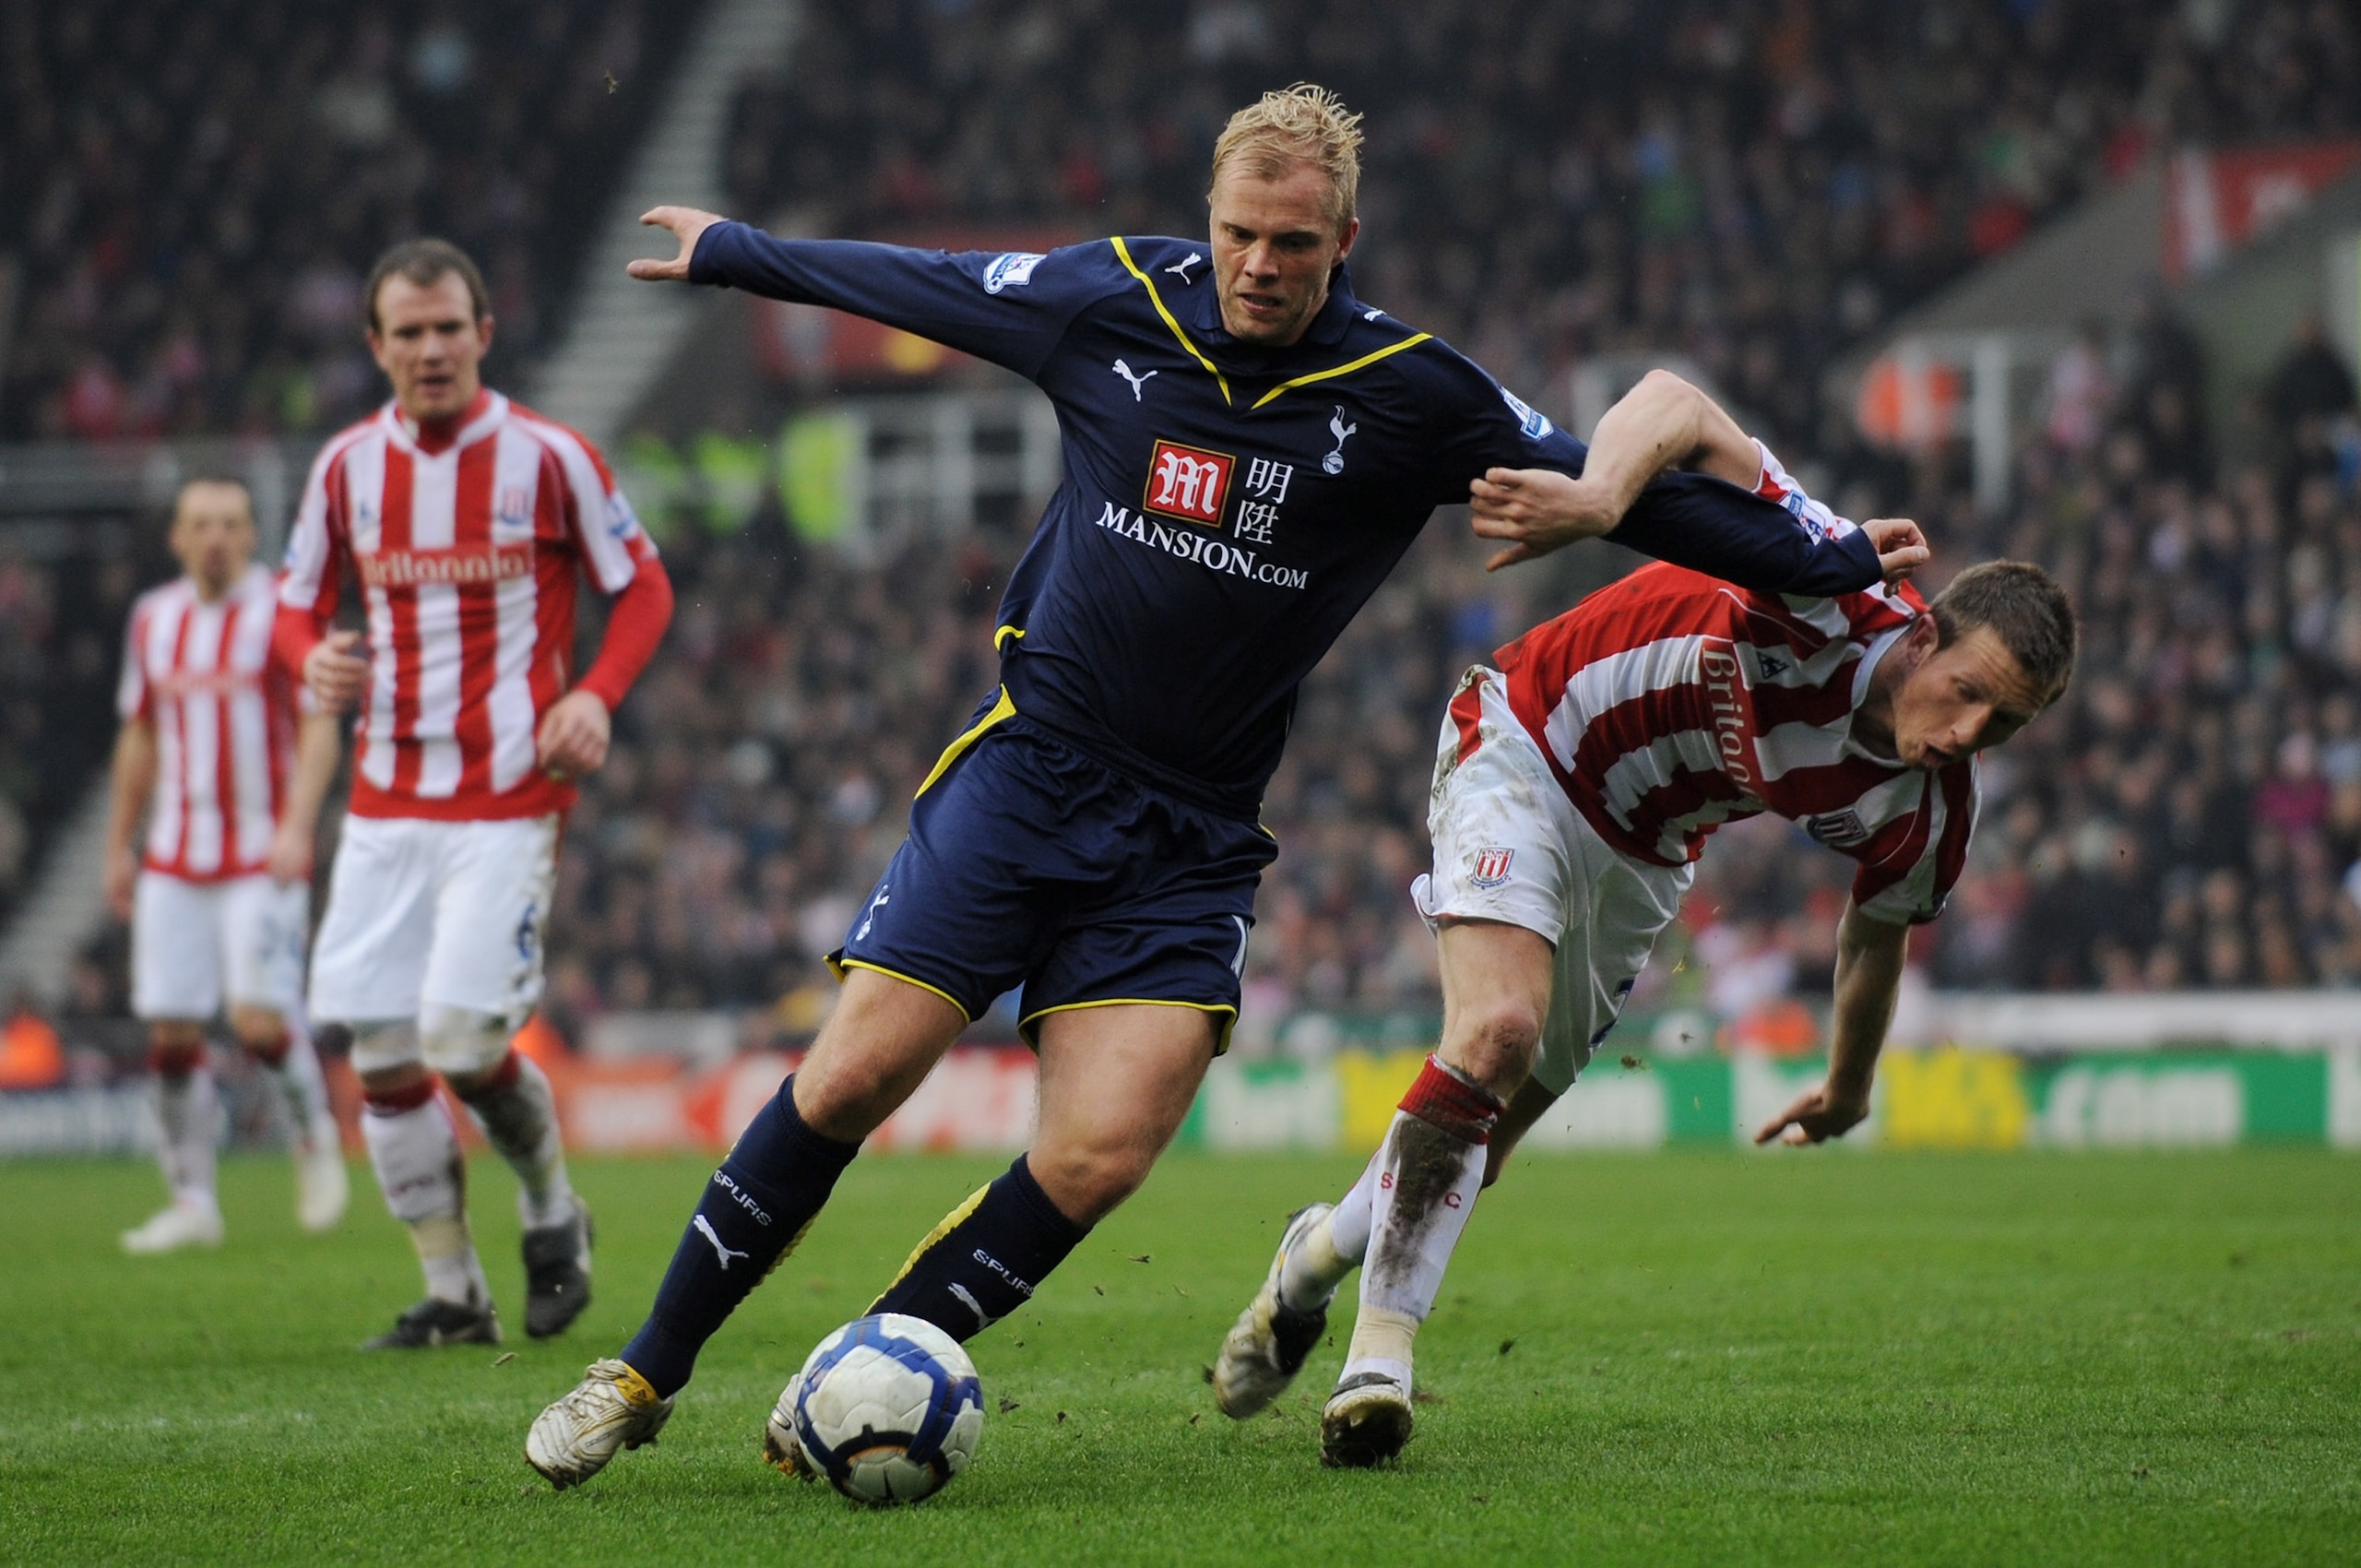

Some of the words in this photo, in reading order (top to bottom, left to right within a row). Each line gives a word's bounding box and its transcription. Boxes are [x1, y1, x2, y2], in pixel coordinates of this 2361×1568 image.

[1096, 501, 1309, 589] MANSION.COM
[714, 1169, 772, 1226] SPURS
[972, 1248, 1035, 1298] SPURS
